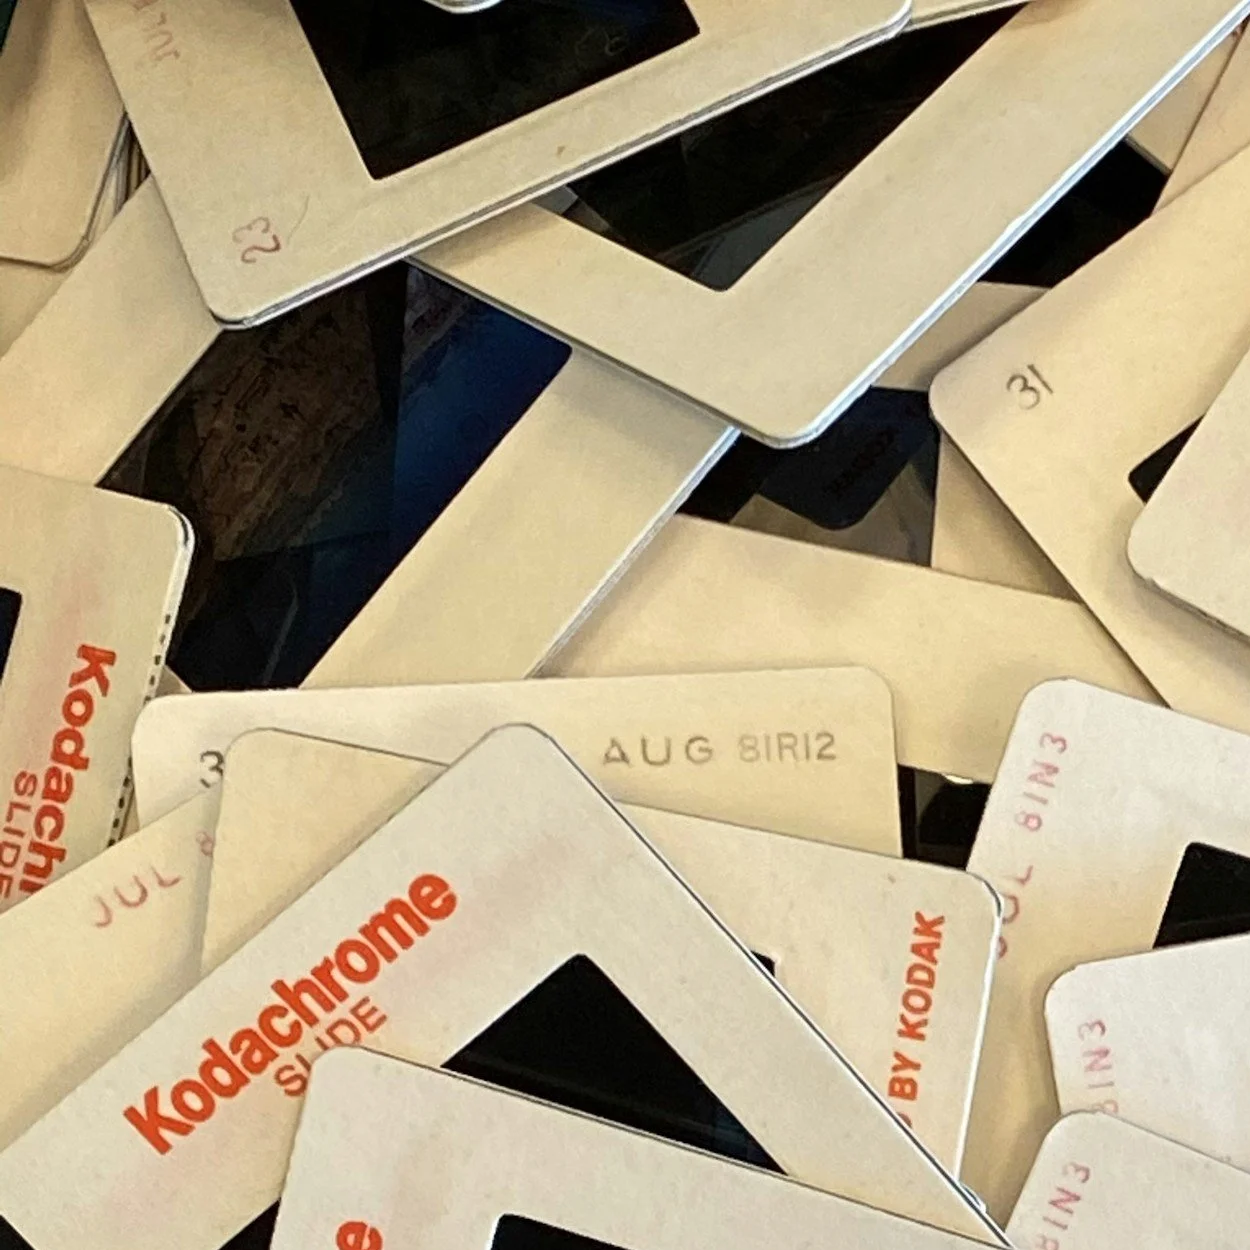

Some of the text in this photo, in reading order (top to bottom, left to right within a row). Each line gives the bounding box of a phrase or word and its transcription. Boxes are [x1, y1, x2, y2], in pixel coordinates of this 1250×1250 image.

[1006, 363, 1054, 410] 31
[603, 735, 714, 768] AUG
[95, 864, 183, 928] JUL
[123, 873, 458, 1156] Kodachrome
[887, 910, 946, 1102] BY KODAK
